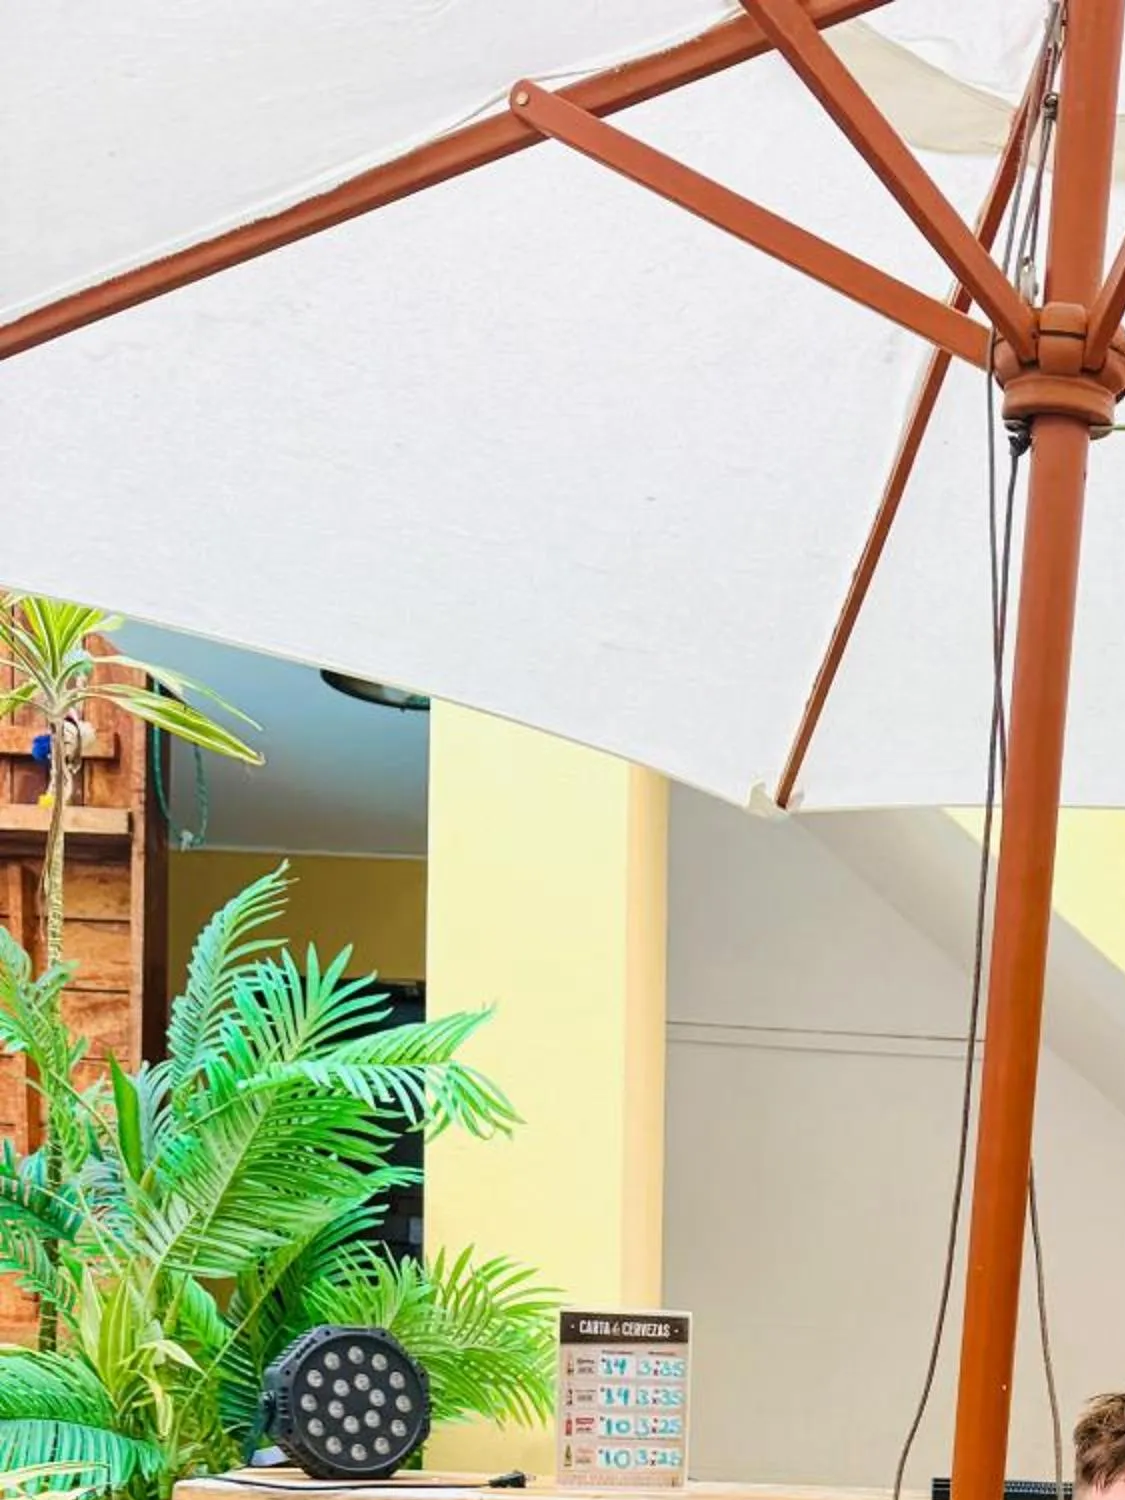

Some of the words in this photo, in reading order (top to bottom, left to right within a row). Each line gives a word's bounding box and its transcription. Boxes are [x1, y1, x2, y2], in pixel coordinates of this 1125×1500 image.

[580, 1319, 611, 1335] CARTA
[622, 1321, 670, 1338] CERVEZAS
[606, 1418, 630, 1435] 10
[605, 1449, 630, 1469] 10
